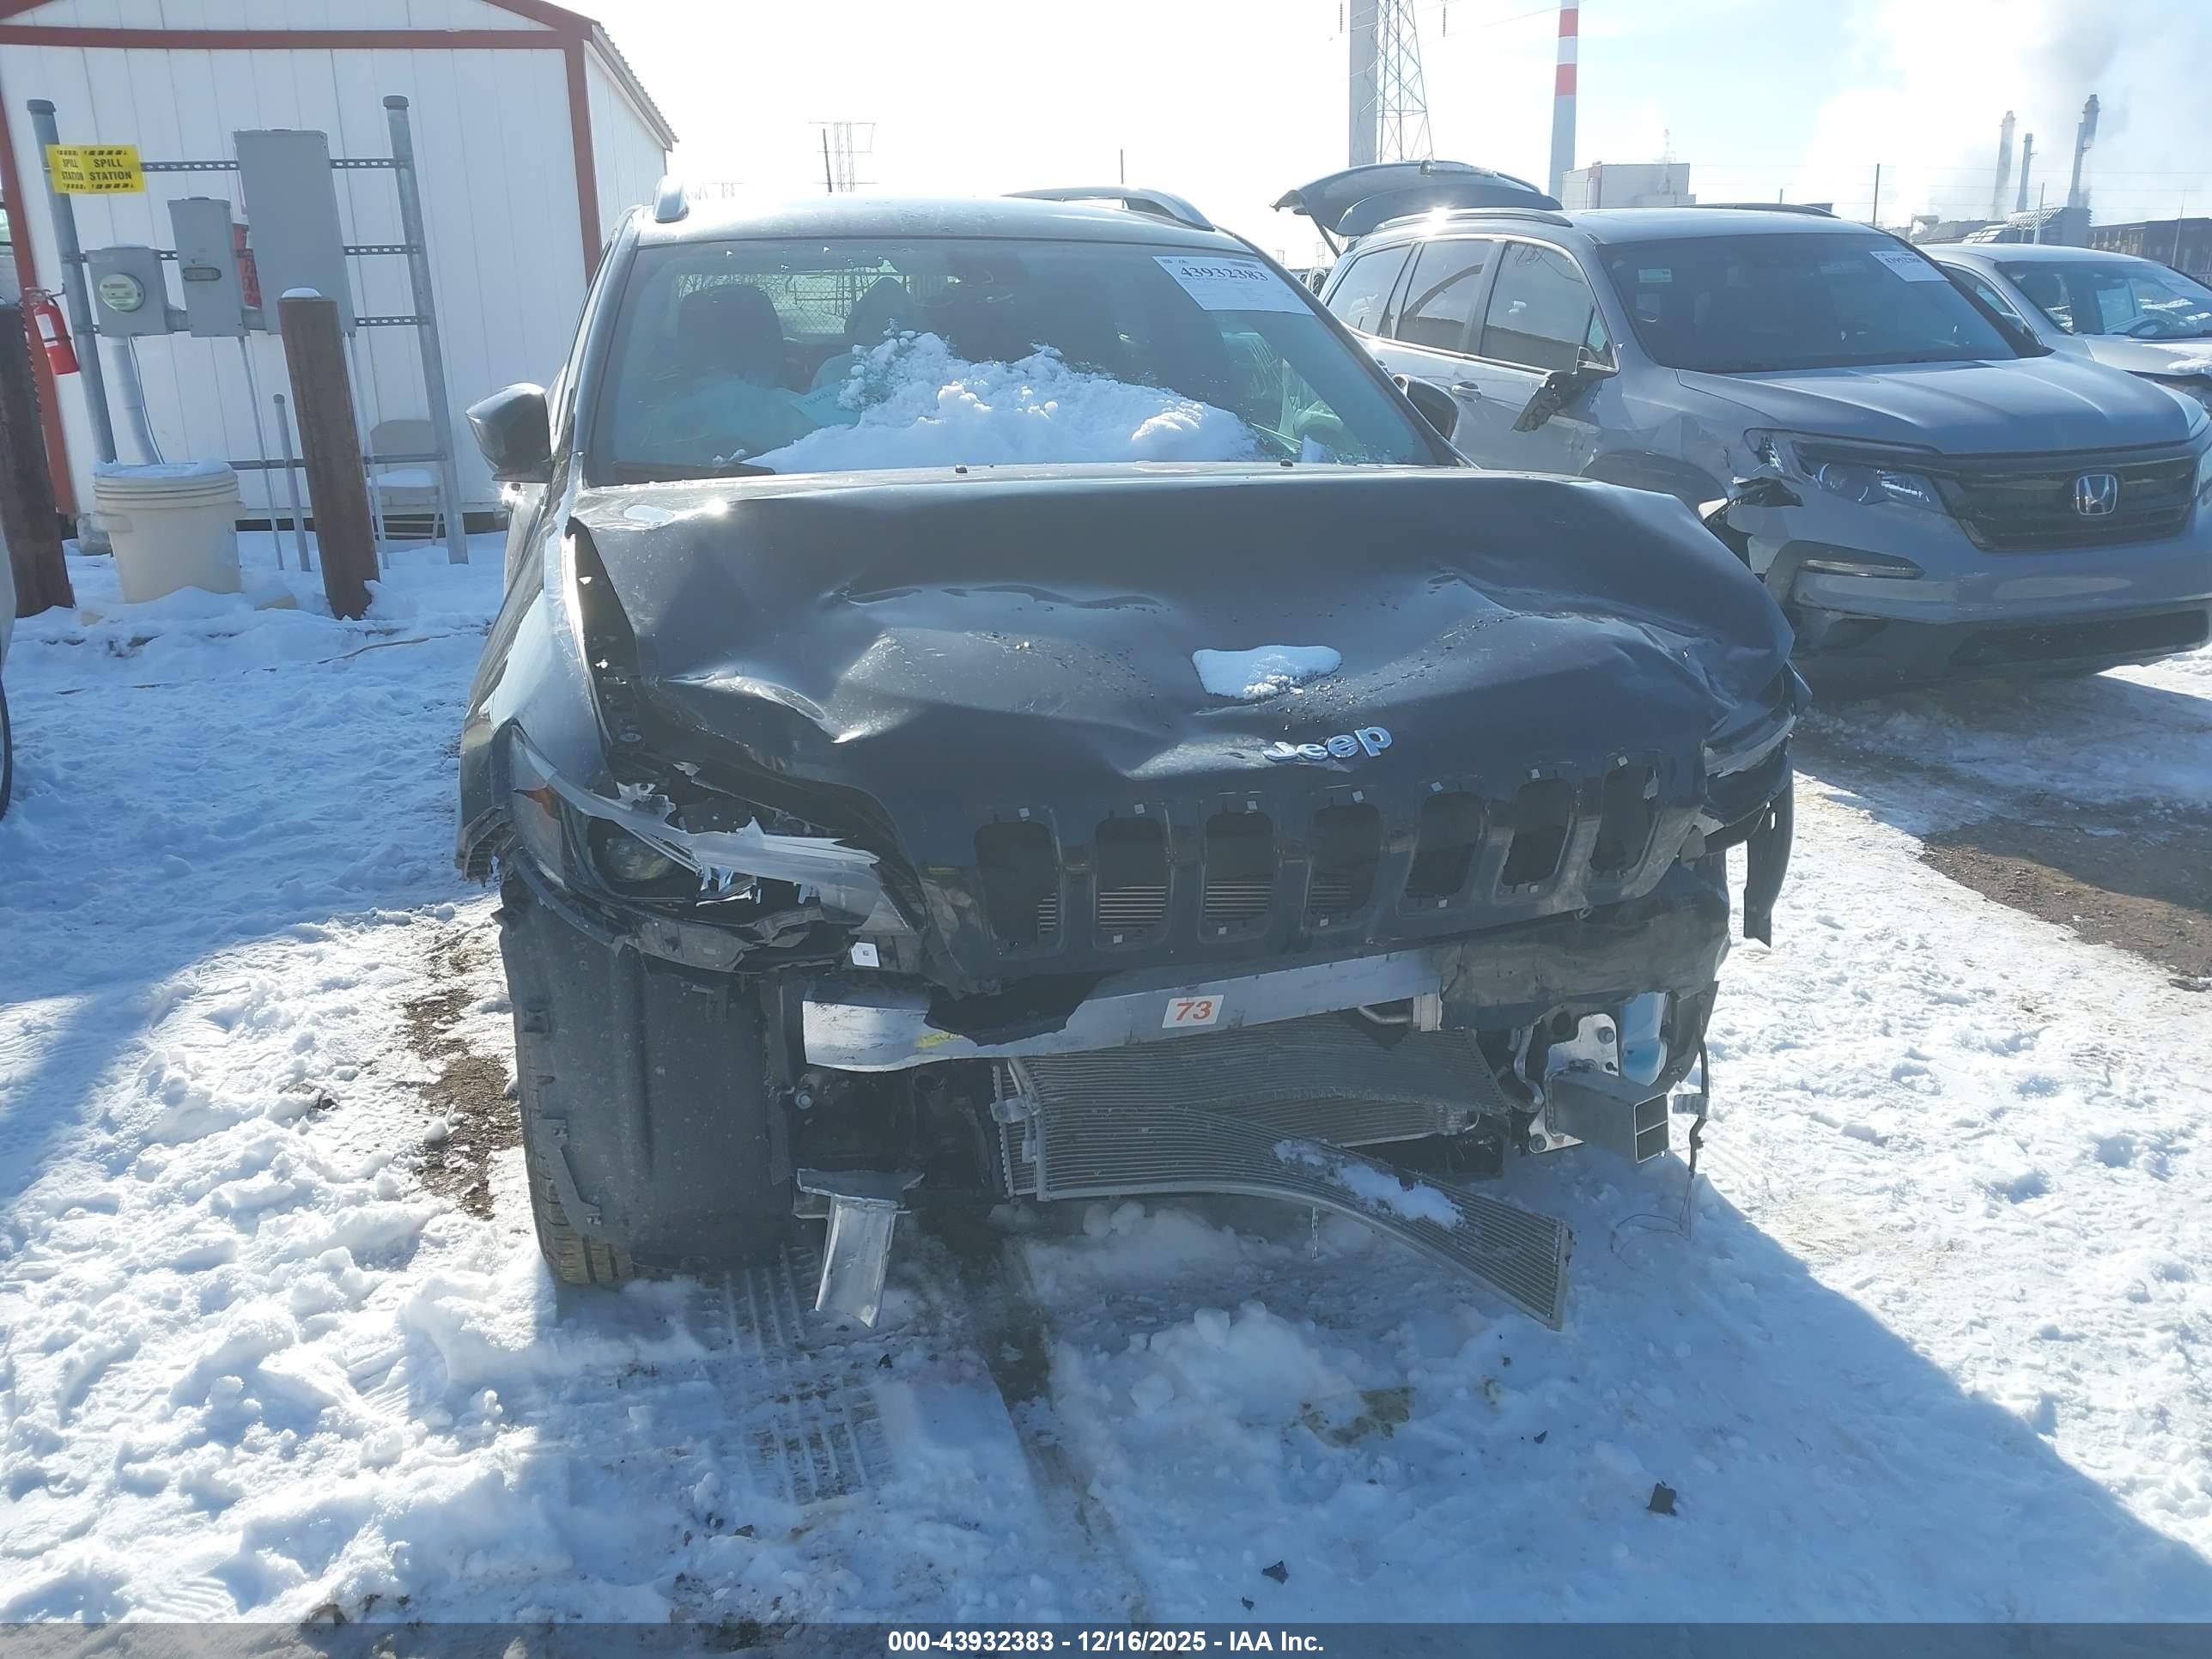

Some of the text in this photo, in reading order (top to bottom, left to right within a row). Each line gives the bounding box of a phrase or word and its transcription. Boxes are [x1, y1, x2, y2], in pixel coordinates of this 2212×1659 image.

[63, 159, 78, 167] SPILL
[94, 158, 123, 167] SPILL
[89, 171, 132, 180] STATION
[1181, 267, 1268, 282] 43932383
[1262, 726, 1393, 761] Jeep
[1176, 1000, 1212, 1021] 73
